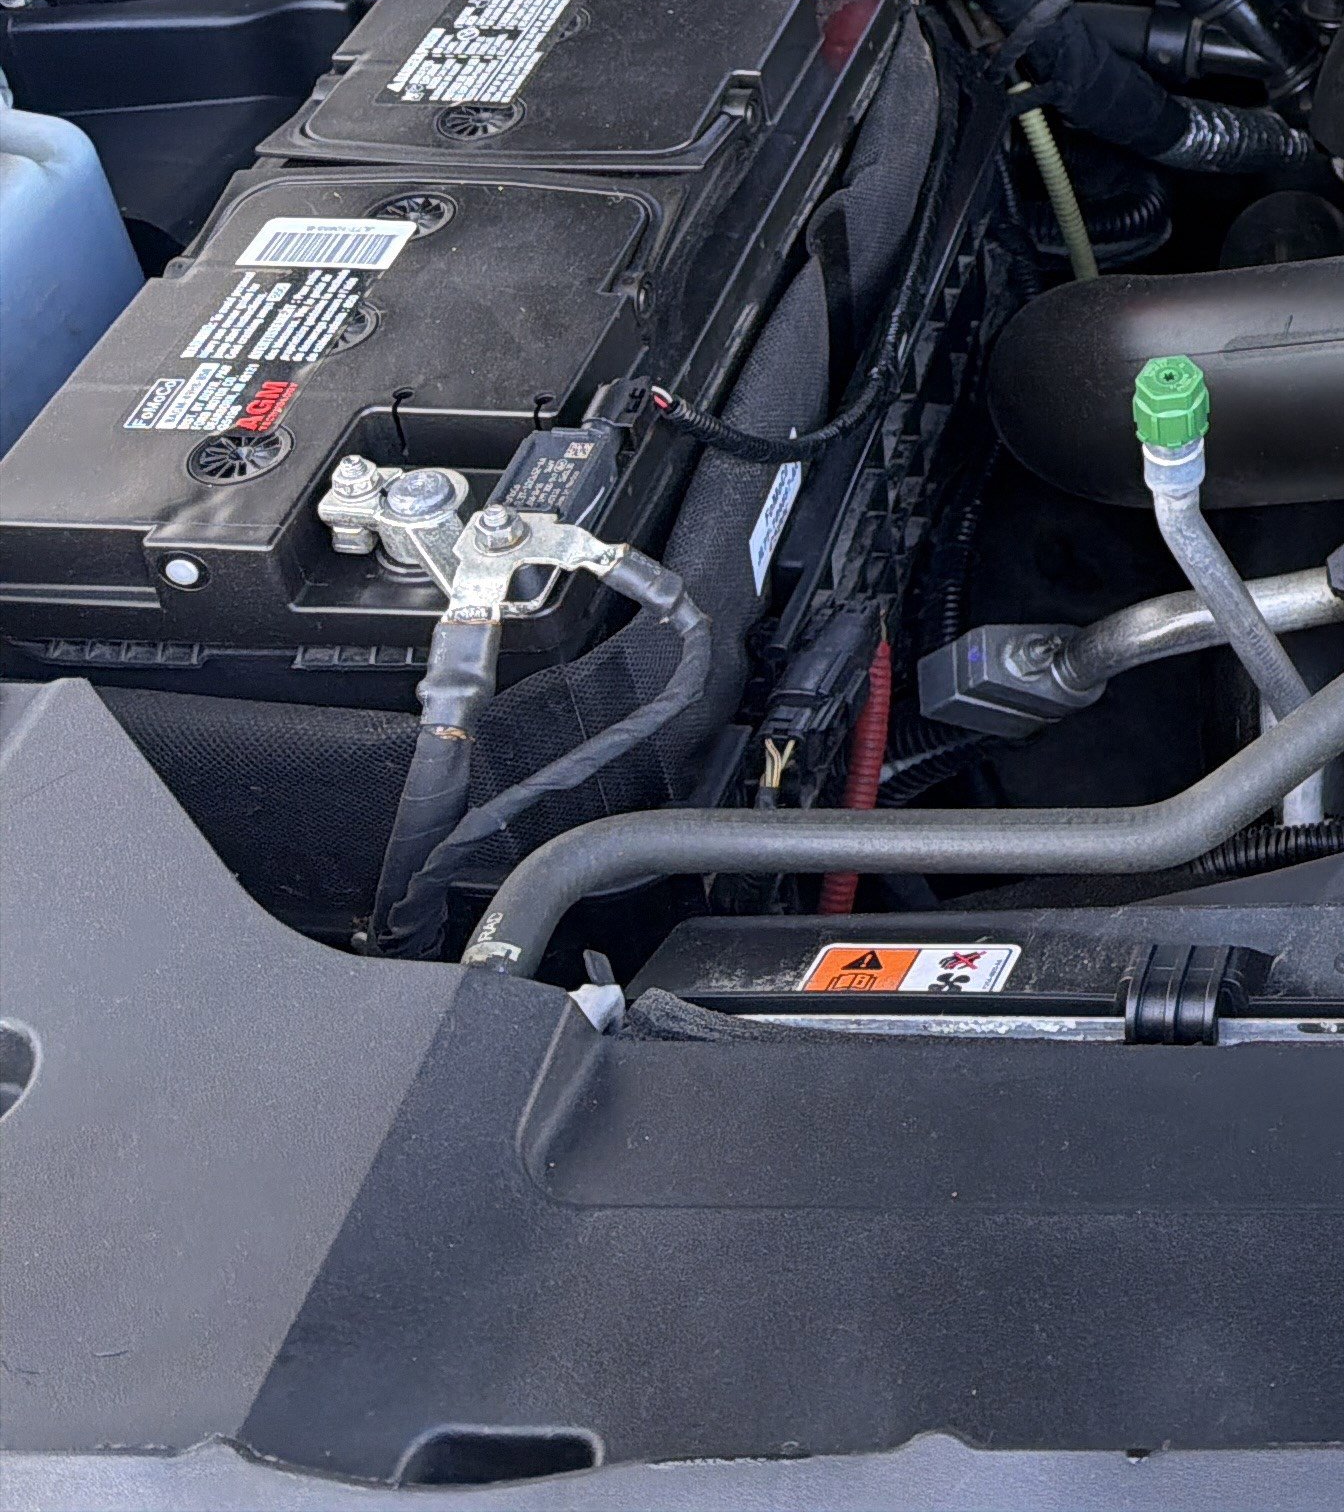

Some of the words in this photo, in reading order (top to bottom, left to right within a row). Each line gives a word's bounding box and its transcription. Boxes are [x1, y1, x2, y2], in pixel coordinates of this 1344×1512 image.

[132, 381, 177, 427] FoMoCo
[237, 381, 289, 431] AGM
[474, 911, 503, 944] RAD
